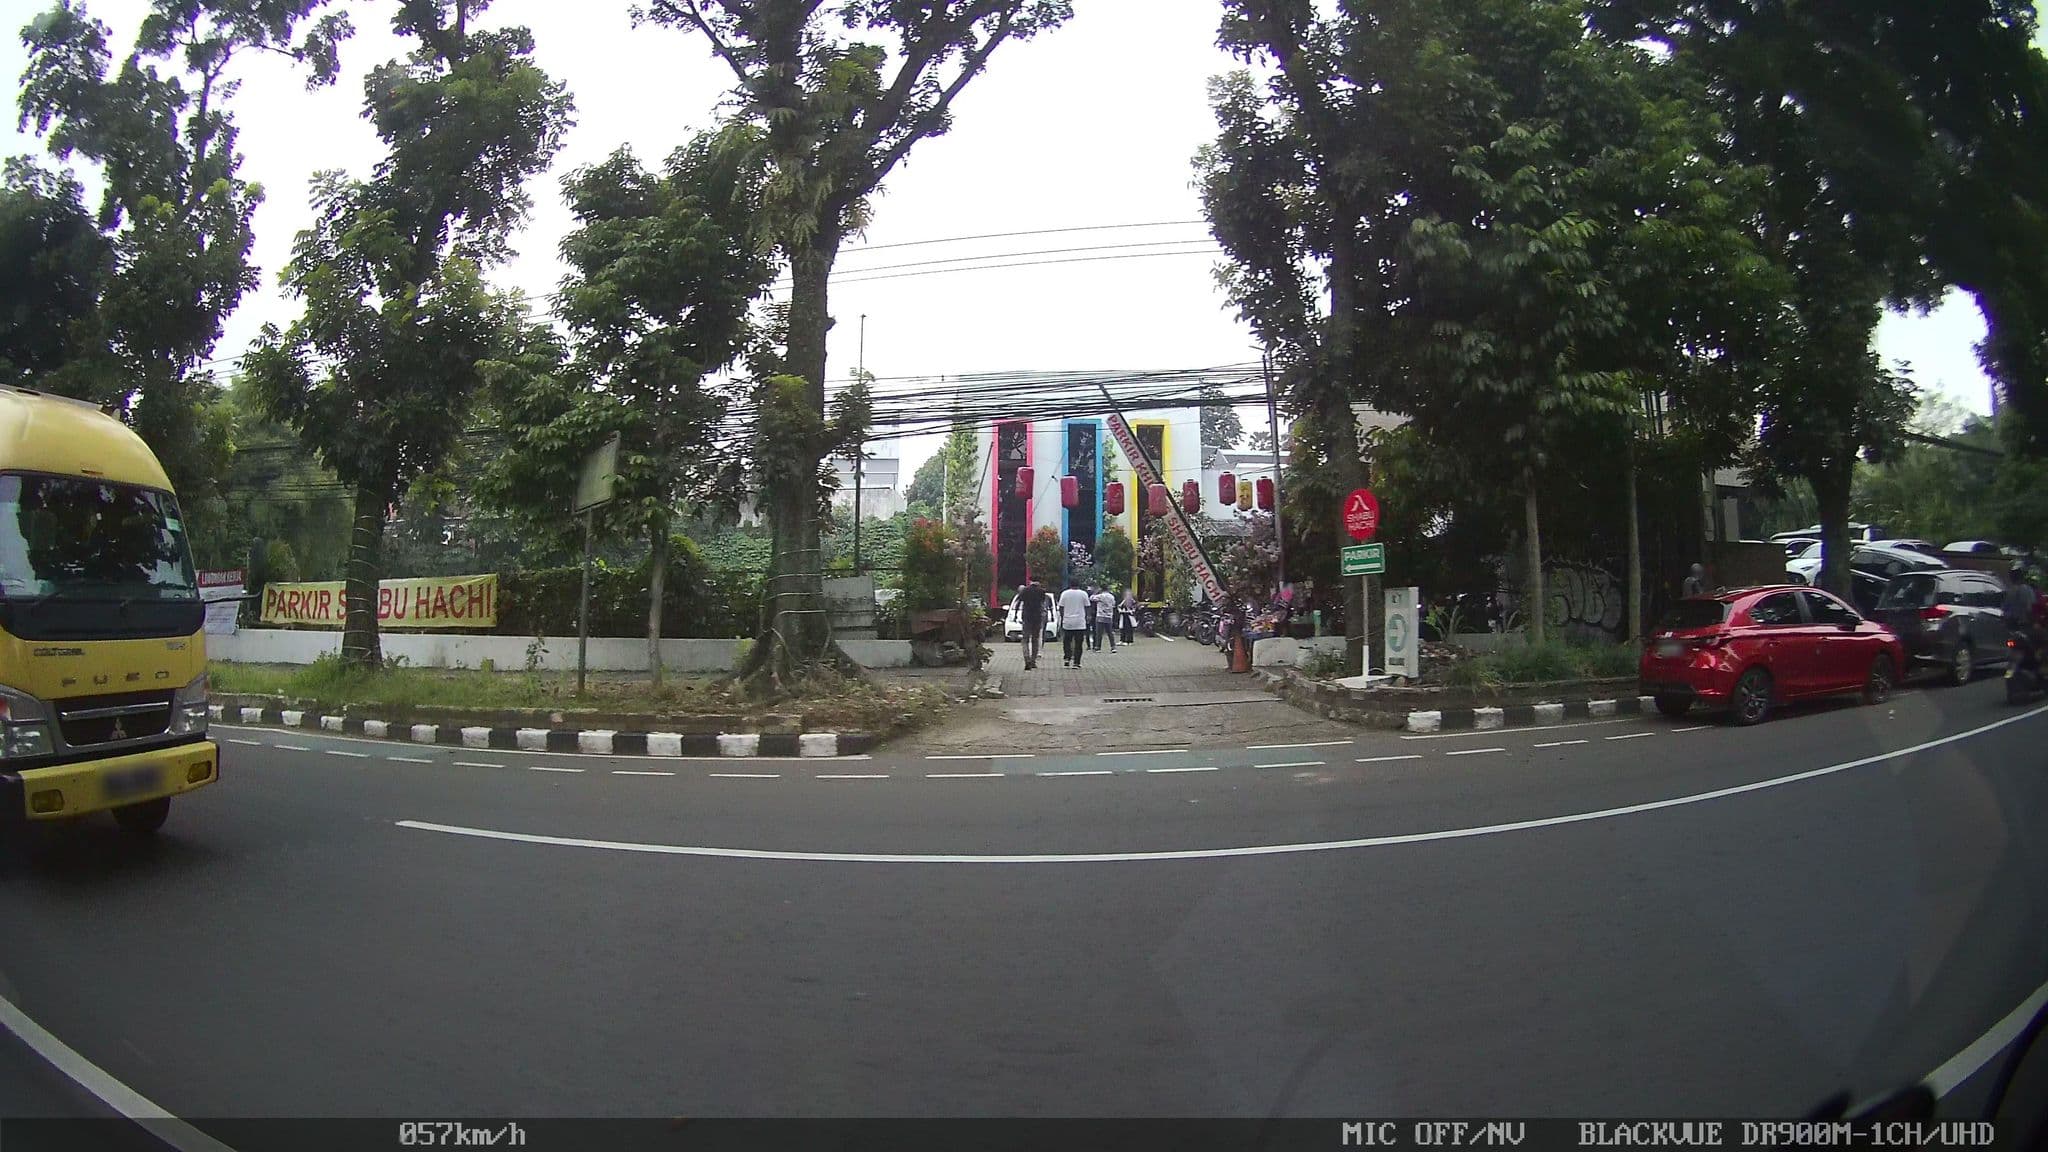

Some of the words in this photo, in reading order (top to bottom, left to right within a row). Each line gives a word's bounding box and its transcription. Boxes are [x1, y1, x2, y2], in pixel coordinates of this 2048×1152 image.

[1108, 414, 1139, 461] PARKIR
[1168, 517, 1197, 559] SHABU
[1194, 561, 1224, 602] HACHI
[1346, 512, 1375, 523] SHABU
[1344, 548, 1380, 562] PARKIR
[265, 588, 332, 620] PARKIR
[337, 587, 408, 620] SBU
[415, 577, 493, 620] HACHI
